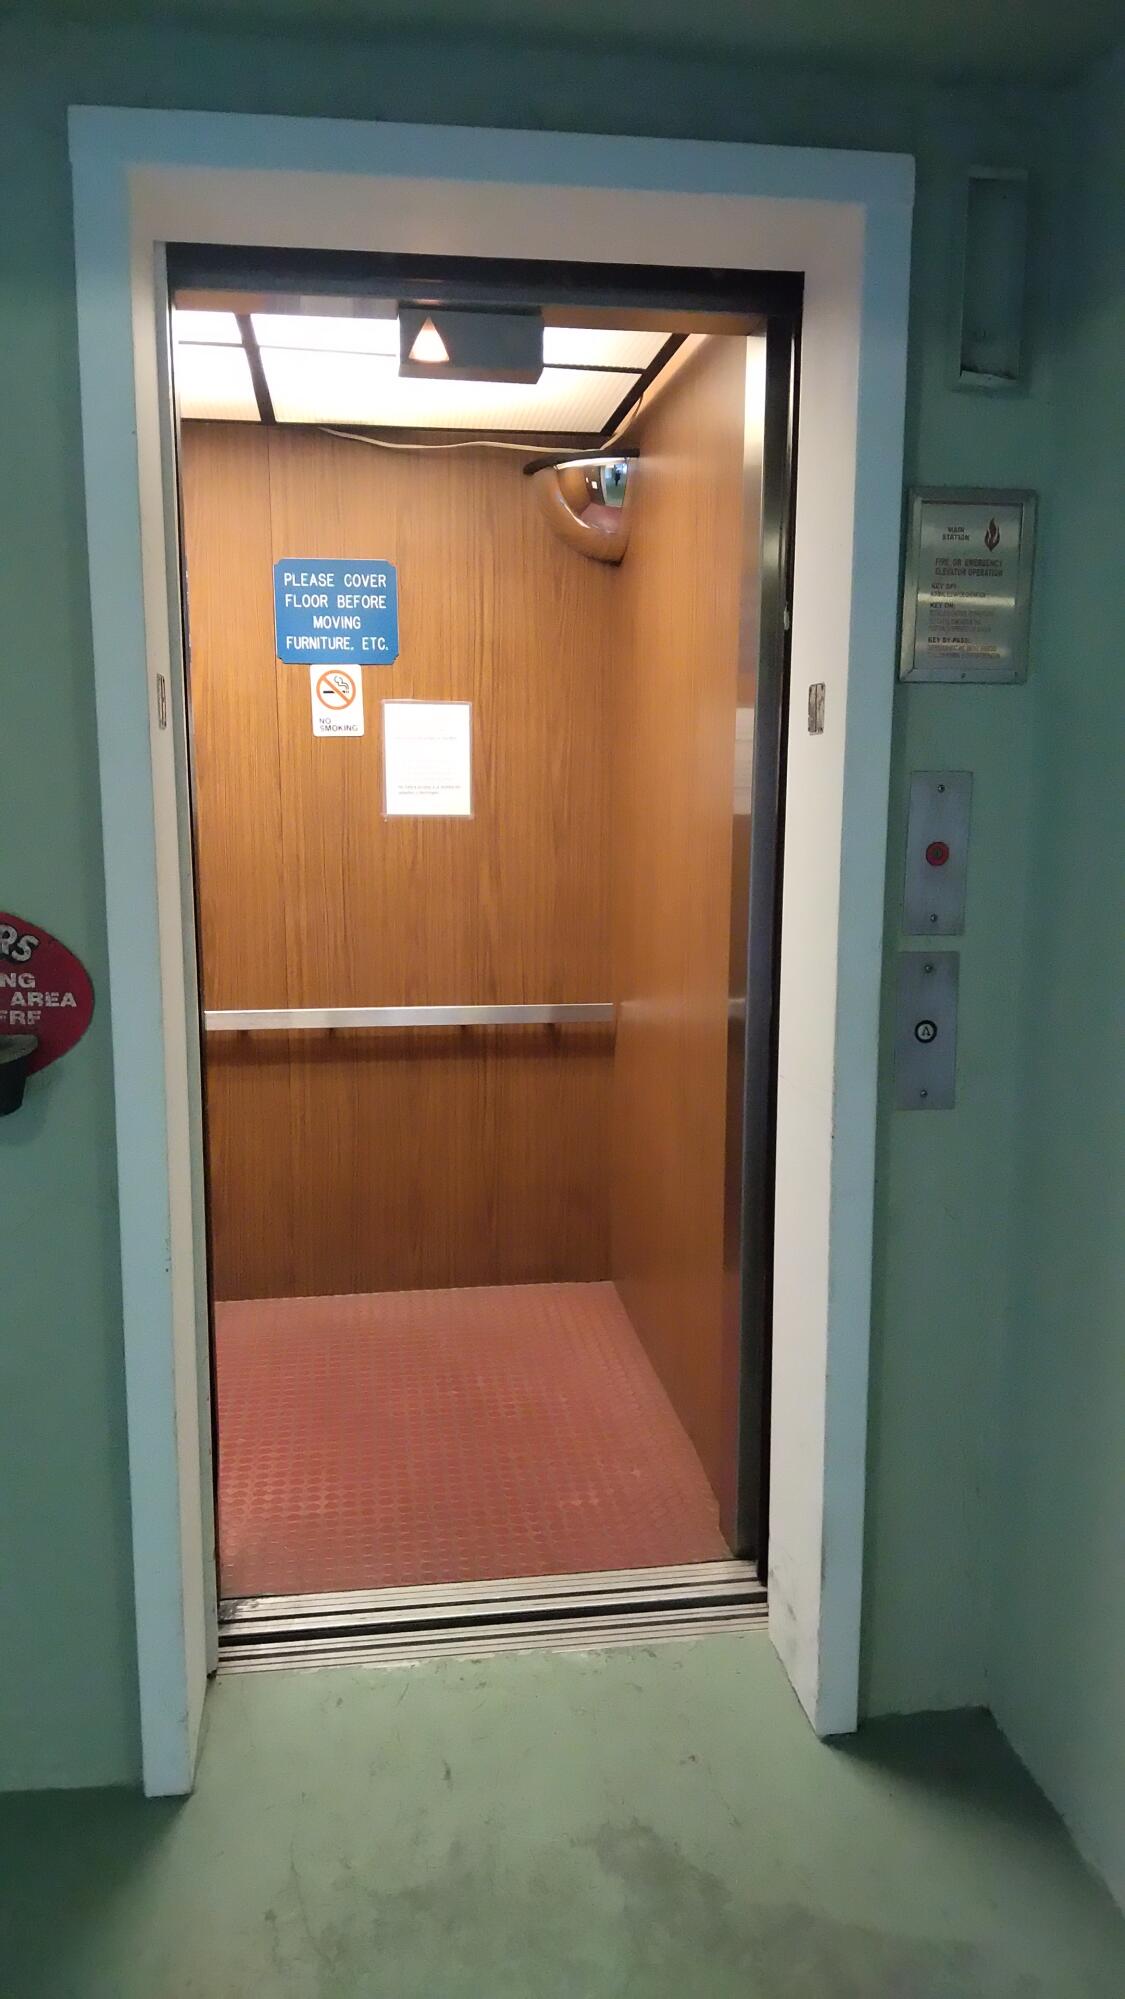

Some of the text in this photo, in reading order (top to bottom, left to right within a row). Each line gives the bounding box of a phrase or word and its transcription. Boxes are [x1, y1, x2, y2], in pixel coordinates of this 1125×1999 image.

[284, 572, 387, 588] PLEASE COVER
[285, 593, 387, 609] FLOOR BEFORE
[313, 615, 361, 630] MOVING
[362, 637, 389, 651] ETC.
[319, 717, 332, 725] NO
[319, 724, 359, 732] SMOKING
[10, 991, 77, 1007] AREA
